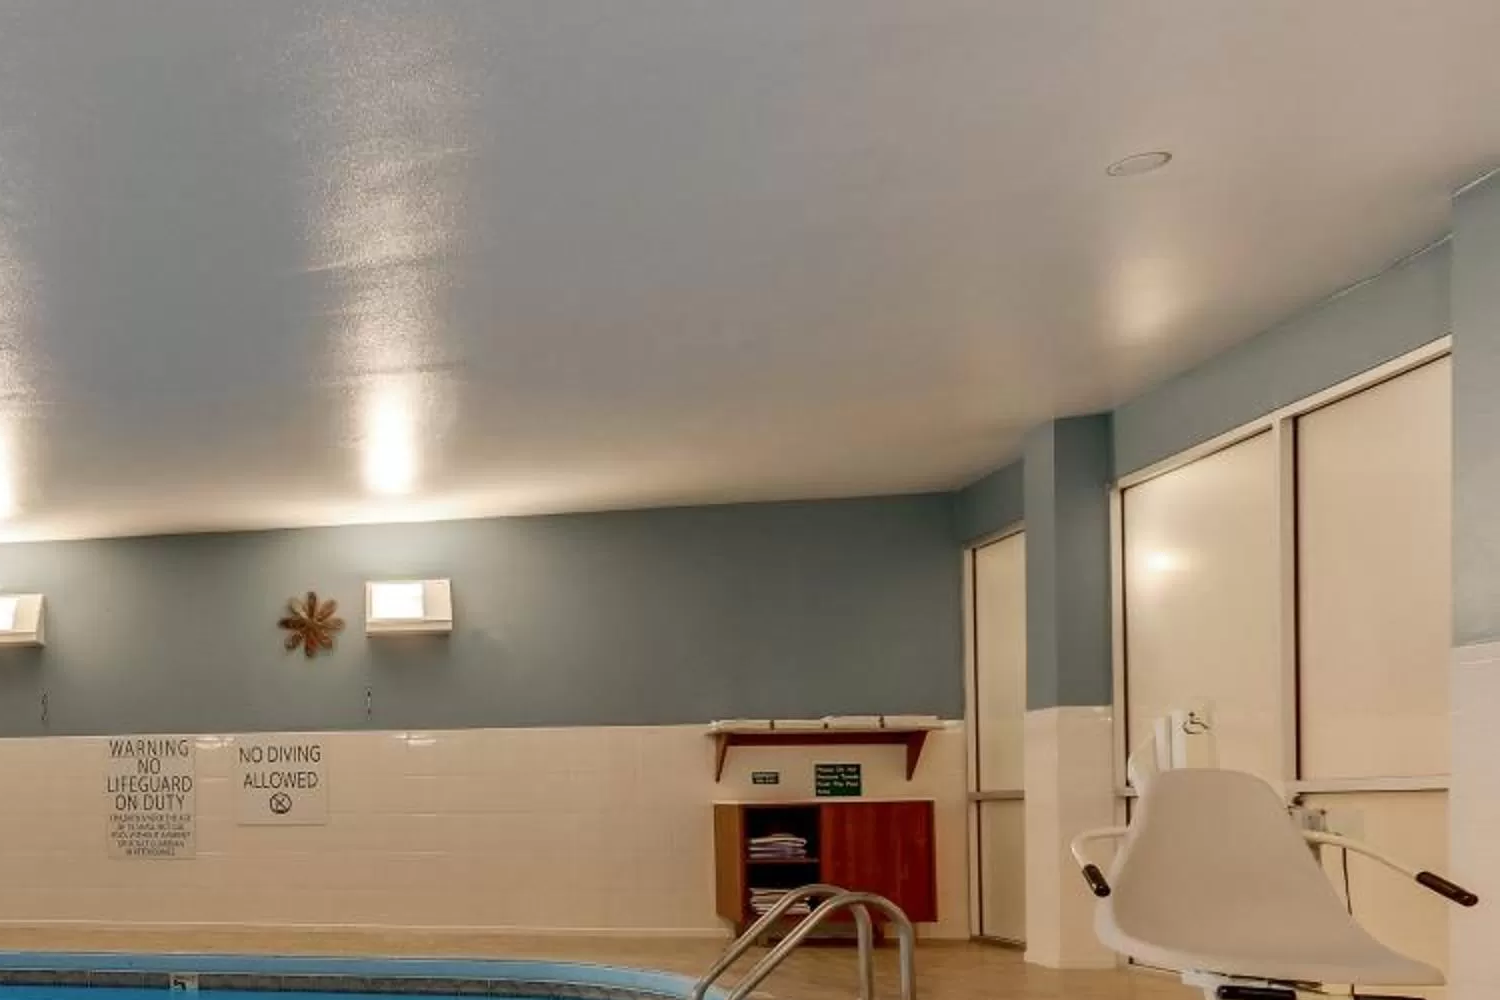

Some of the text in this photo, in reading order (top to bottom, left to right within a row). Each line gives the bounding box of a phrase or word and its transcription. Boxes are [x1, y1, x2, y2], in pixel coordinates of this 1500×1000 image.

[109, 739, 189, 757] WARNING
[239, 745, 321, 763] NO DIVING
[138, 757, 161, 774] NO
[107, 775, 193, 793] LIFEGUARD
[243, 771, 319, 789] ALLOWED
[116, 793, 185, 811] ON DUTY
